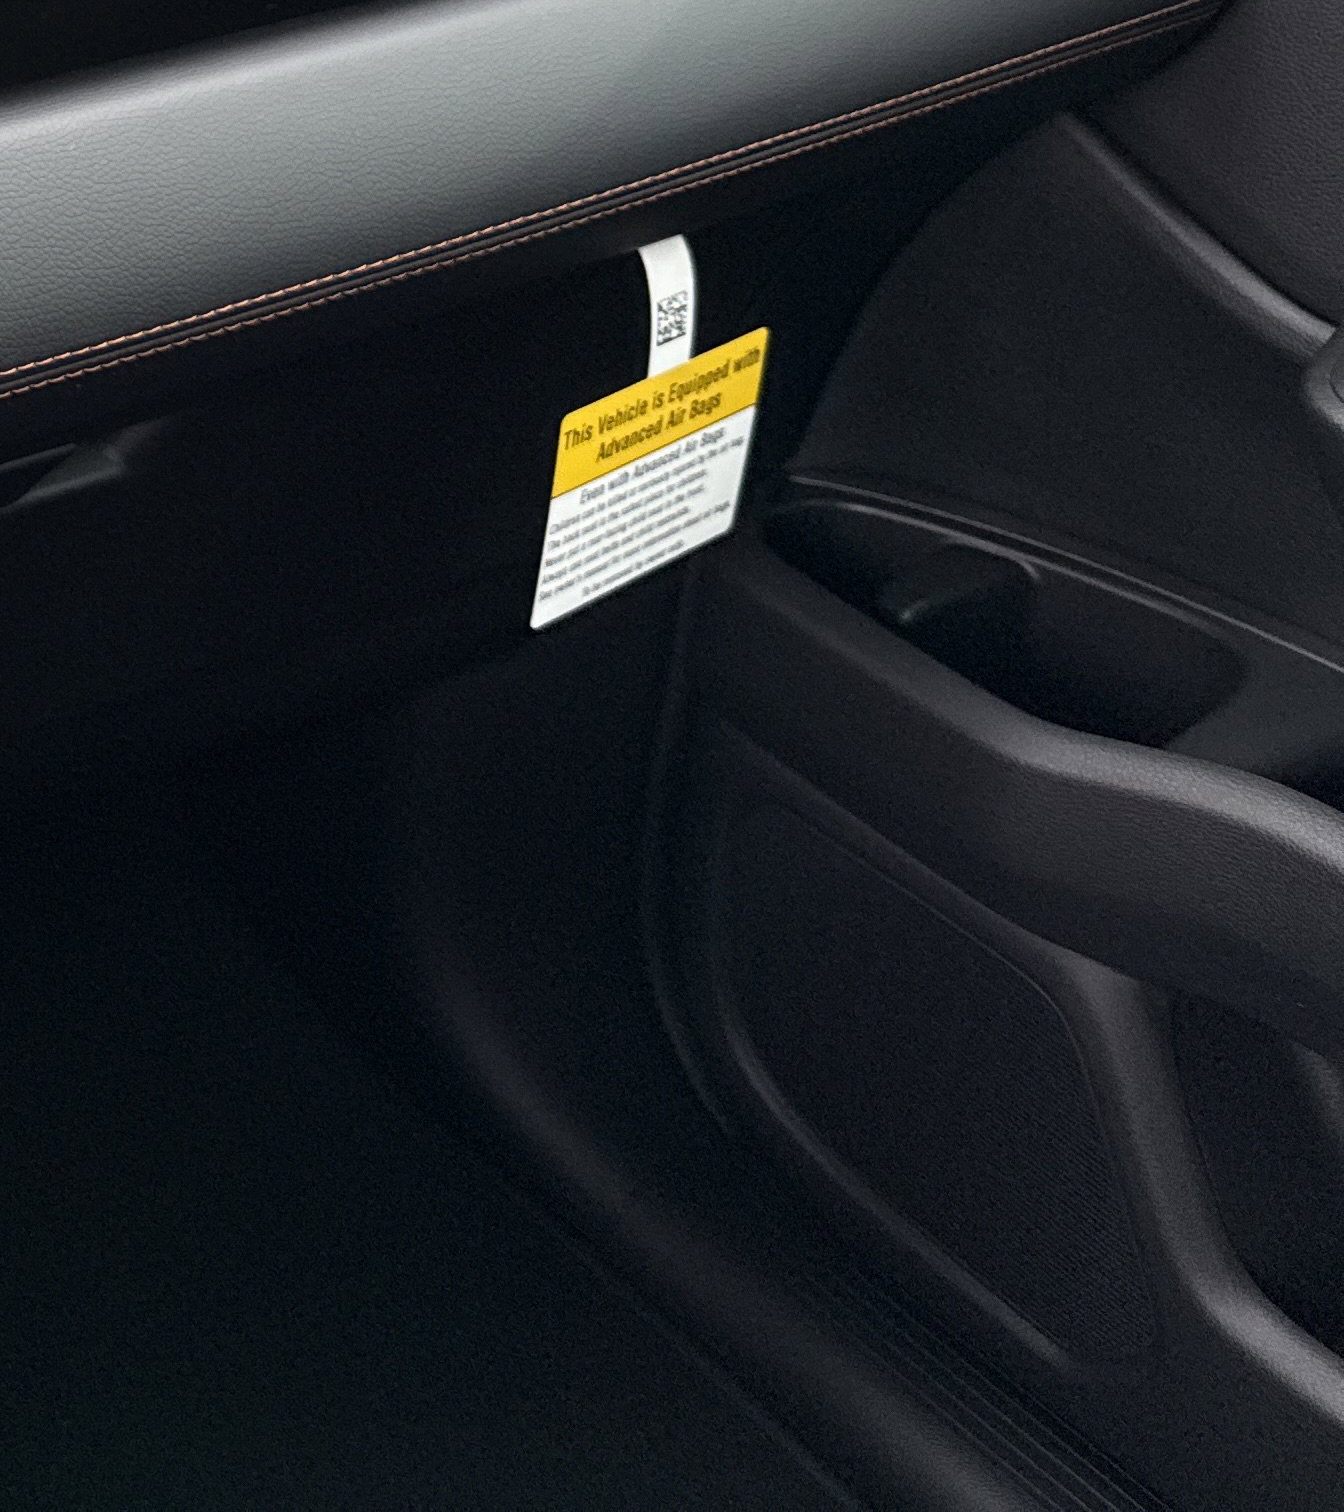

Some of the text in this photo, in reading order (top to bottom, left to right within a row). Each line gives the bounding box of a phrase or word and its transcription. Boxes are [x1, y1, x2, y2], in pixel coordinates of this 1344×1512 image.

[564, 422, 594, 450] This
[598, 398, 649, 434] Vehicle
[652, 391, 665, 410] is
[668, 358, 731, 403] Equipped
[595, 392, 723, 463] Advanced Air Bags
